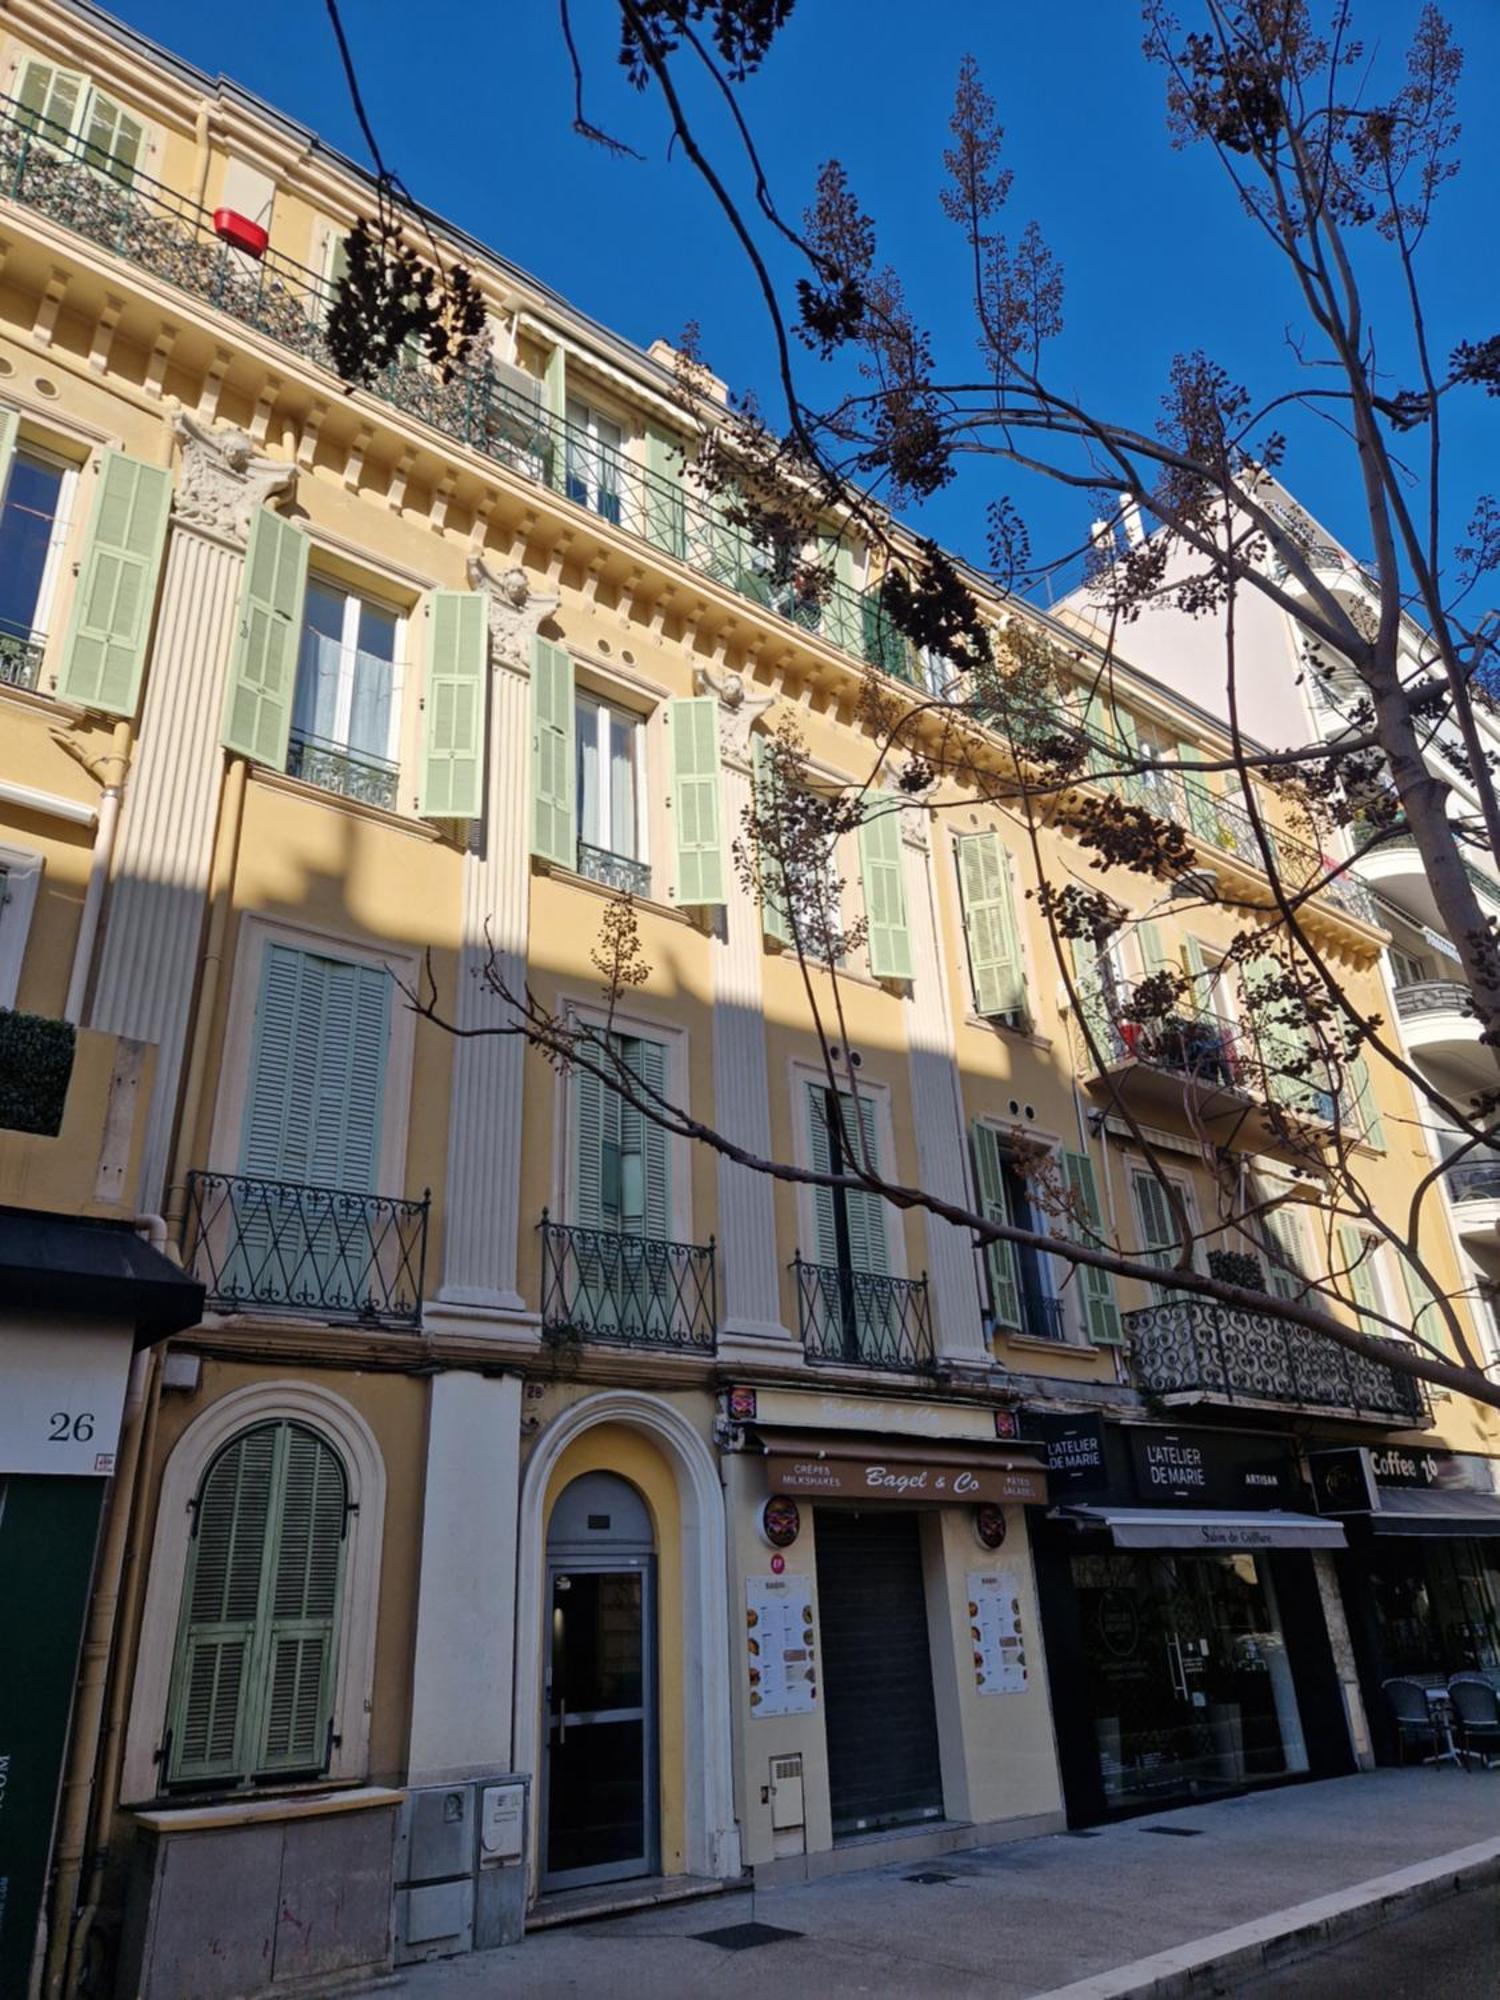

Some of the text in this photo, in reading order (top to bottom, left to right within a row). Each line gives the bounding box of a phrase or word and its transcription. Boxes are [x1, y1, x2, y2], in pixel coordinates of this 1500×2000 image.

[48, 1412, 95, 1442] 26
[1047, 1437, 1099, 1456] L'ATELIER
[1146, 1445, 1202, 1465] L'ATELIER
[1049, 1451, 1102, 1470] DE MARIE
[1369, 1450, 1417, 1477] Coffee
[782, 1474, 841, 1487] MILKSHAKES
[865, 1467, 979, 1495] Bagel & Co
[1150, 1466, 1206, 1486] DE MARIE
[1245, 1473, 1279, 1485] ARTISAN
[1201, 1526, 1227, 1542] Salon
[1228, 1531, 1239, 1543] de
